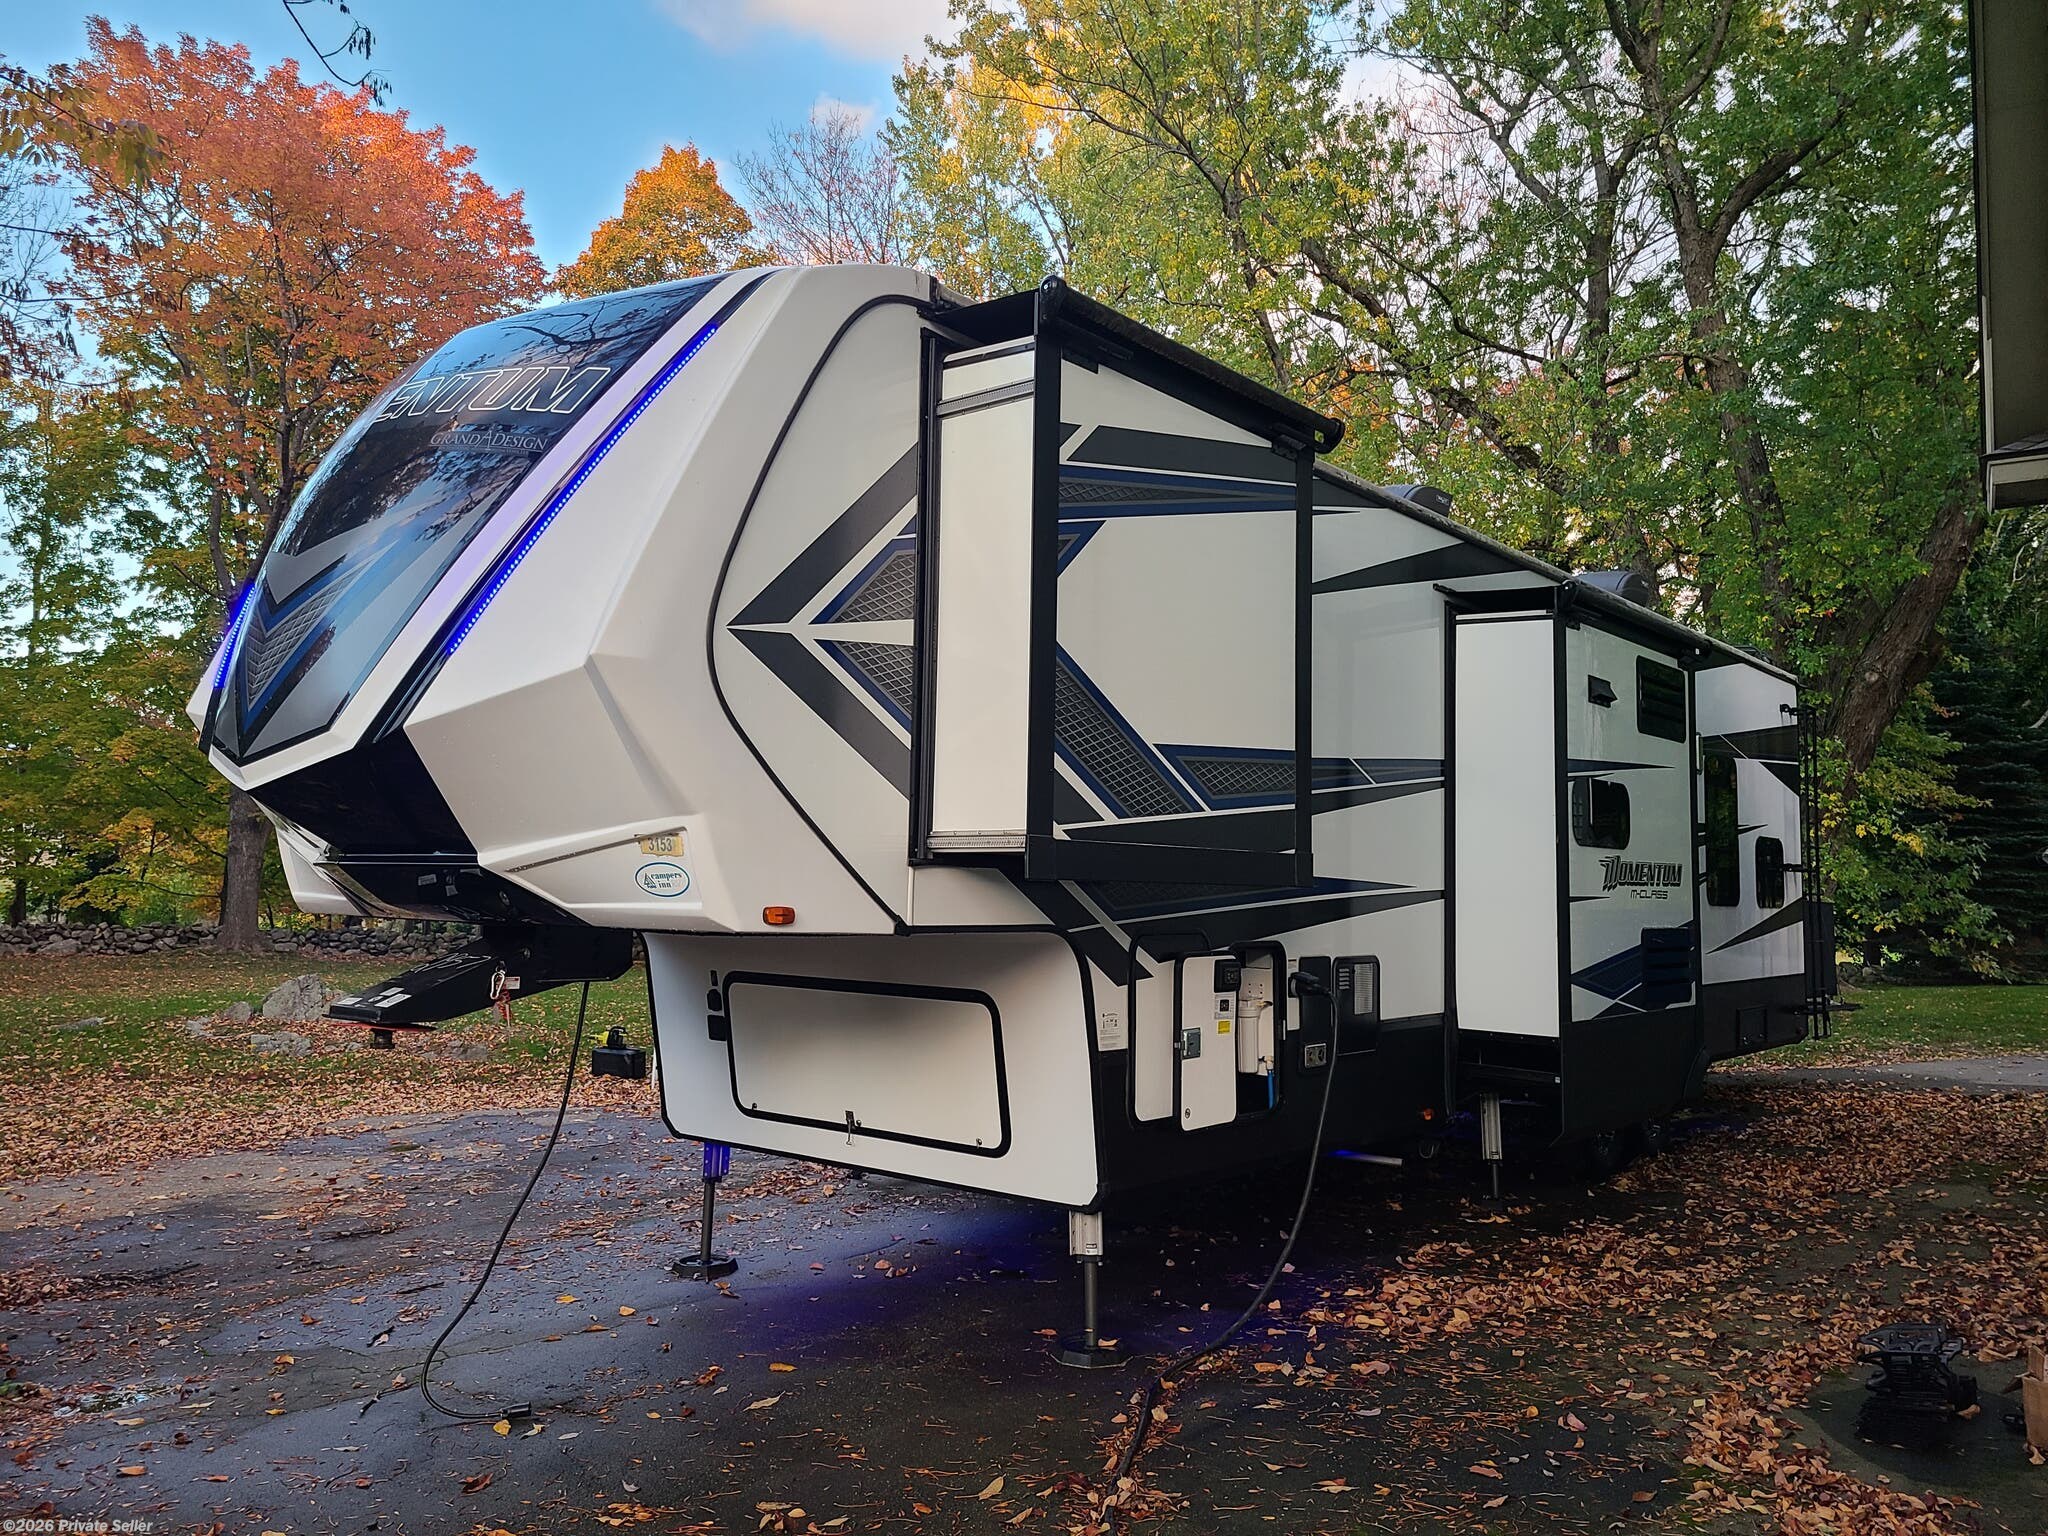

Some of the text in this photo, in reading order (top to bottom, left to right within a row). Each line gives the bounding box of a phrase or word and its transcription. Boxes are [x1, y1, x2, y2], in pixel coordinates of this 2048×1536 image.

[430, 432, 548, 450] GRAND DESIGN
[648, 837, 672, 851] 3153
[1599, 855, 1682, 892] MOMENTUM
[657, 880, 672, 888] inn
